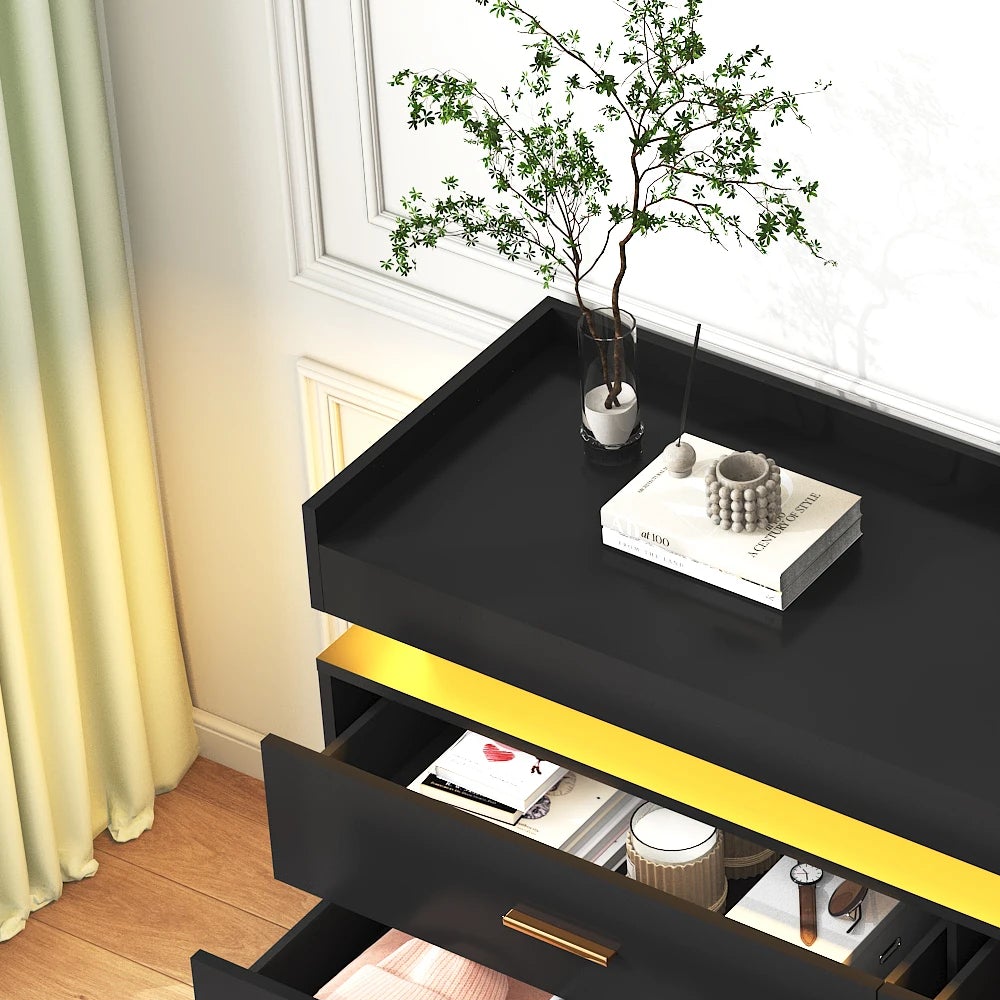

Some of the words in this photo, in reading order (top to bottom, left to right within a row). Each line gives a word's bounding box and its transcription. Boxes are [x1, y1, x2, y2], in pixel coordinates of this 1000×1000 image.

[641, 531, 650, 539] at
[652, 533, 670, 547] 100
[754, 520, 789, 551] CENTURY
[786, 511, 799, 522] OF
[795, 492, 821, 513] STYLE
